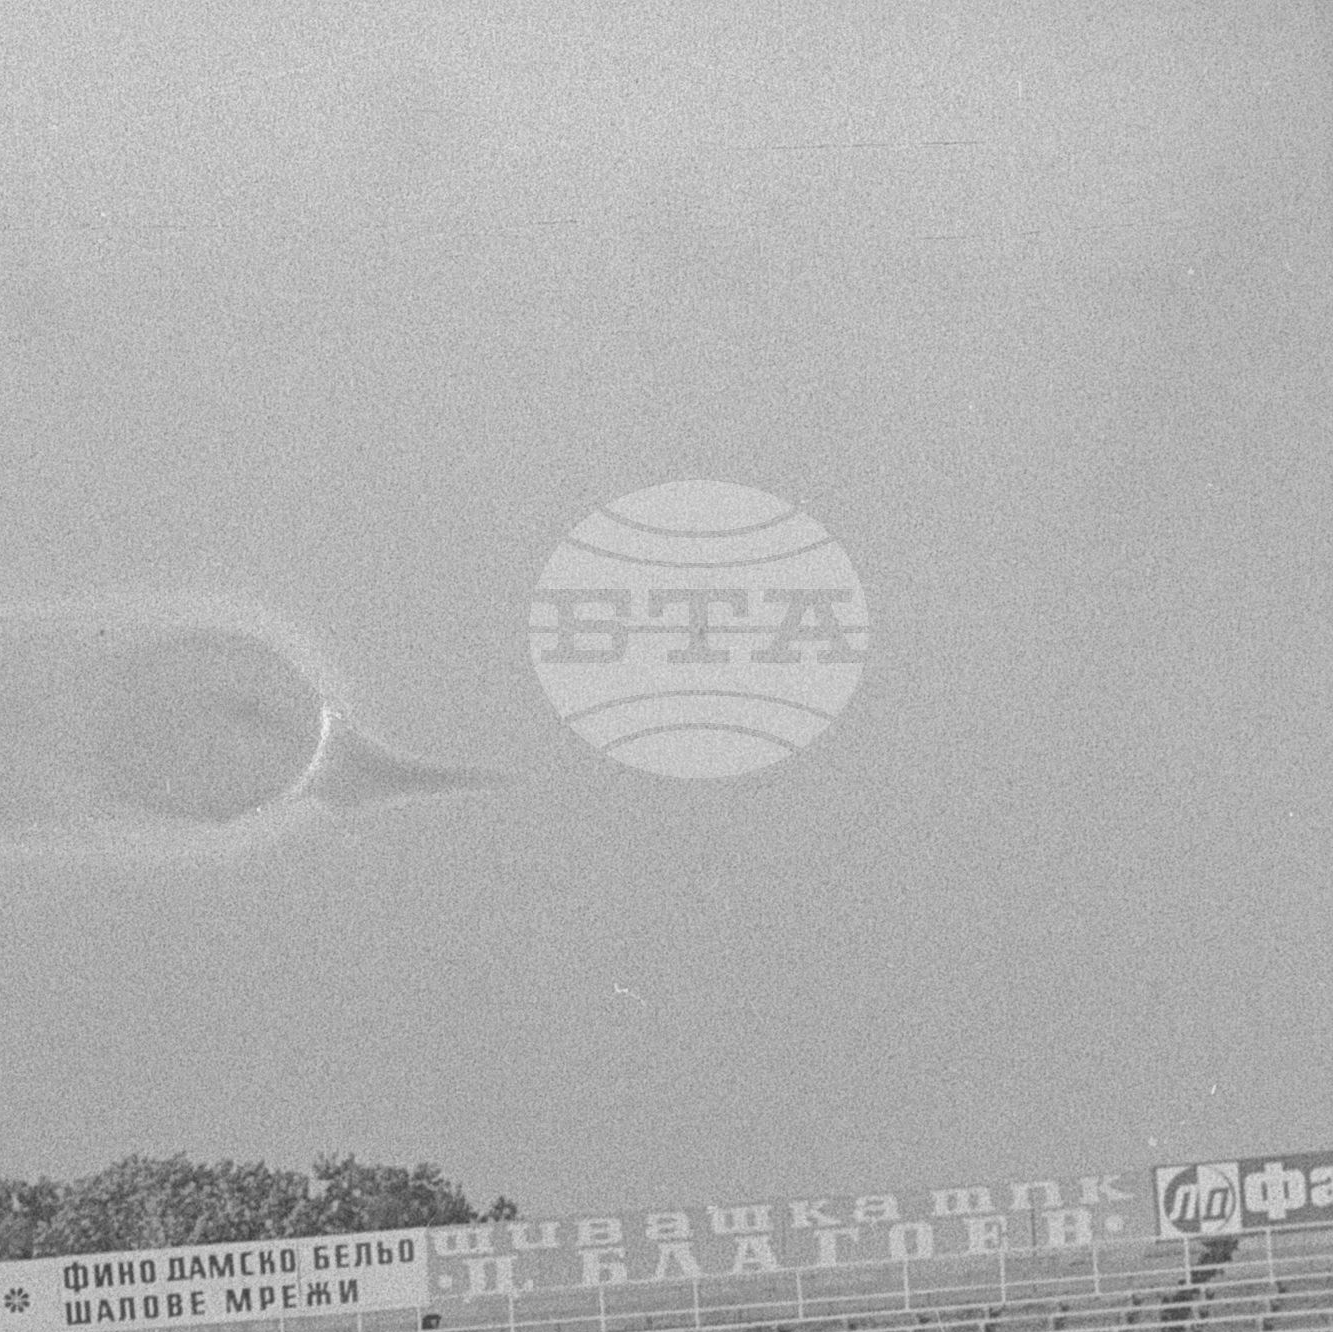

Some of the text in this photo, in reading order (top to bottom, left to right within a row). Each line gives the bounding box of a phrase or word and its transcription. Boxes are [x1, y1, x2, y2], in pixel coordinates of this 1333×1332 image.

[64, 1238, 415, 1291] ФИНО ДАМСКО БЕЛЬО
[65, 1278, 359, 1326] ШАЛОВЕ МРЕЖИ
